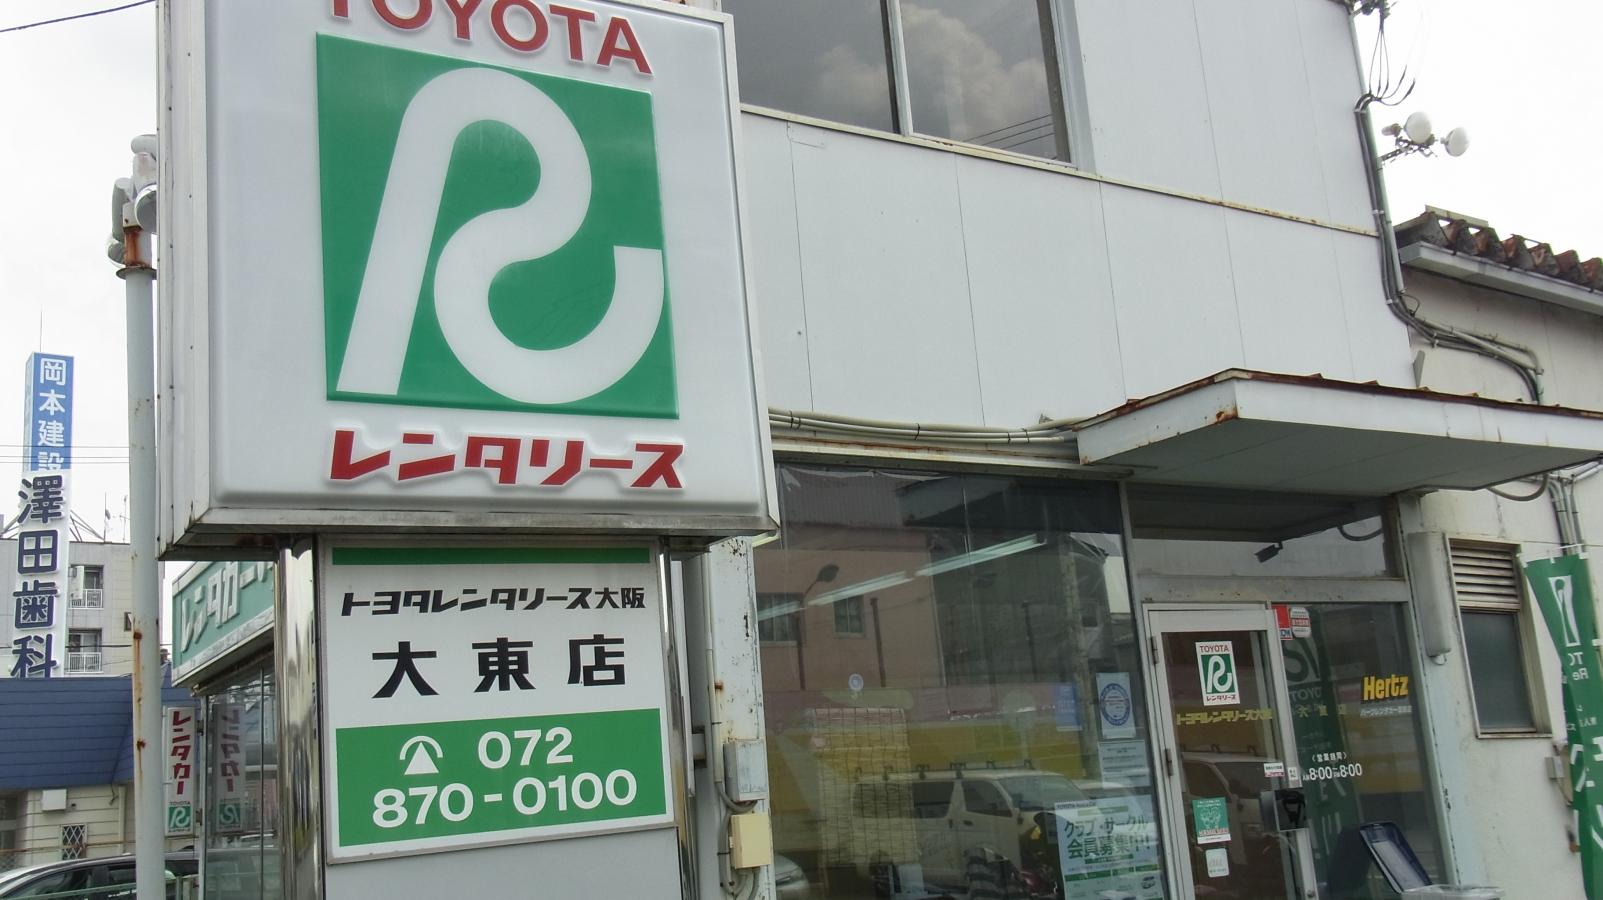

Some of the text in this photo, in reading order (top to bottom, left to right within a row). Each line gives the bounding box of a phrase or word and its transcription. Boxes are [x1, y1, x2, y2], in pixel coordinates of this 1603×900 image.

[37, 357, 67, 471] 岡本建設
[330, 430, 684, 489] レンタリース
[10, 474, 64, 678] 澤田歯科
[341, 587, 646, 617] トヨタレンタリース大阪
[372, 634, 625, 699] 大東店
[1199, 645, 1230, 653] TOYOTA
[1363, 674, 1409, 701] Hertz
[171, 710, 192, 795] レンタカー
[477, 726, 574, 769] 072
